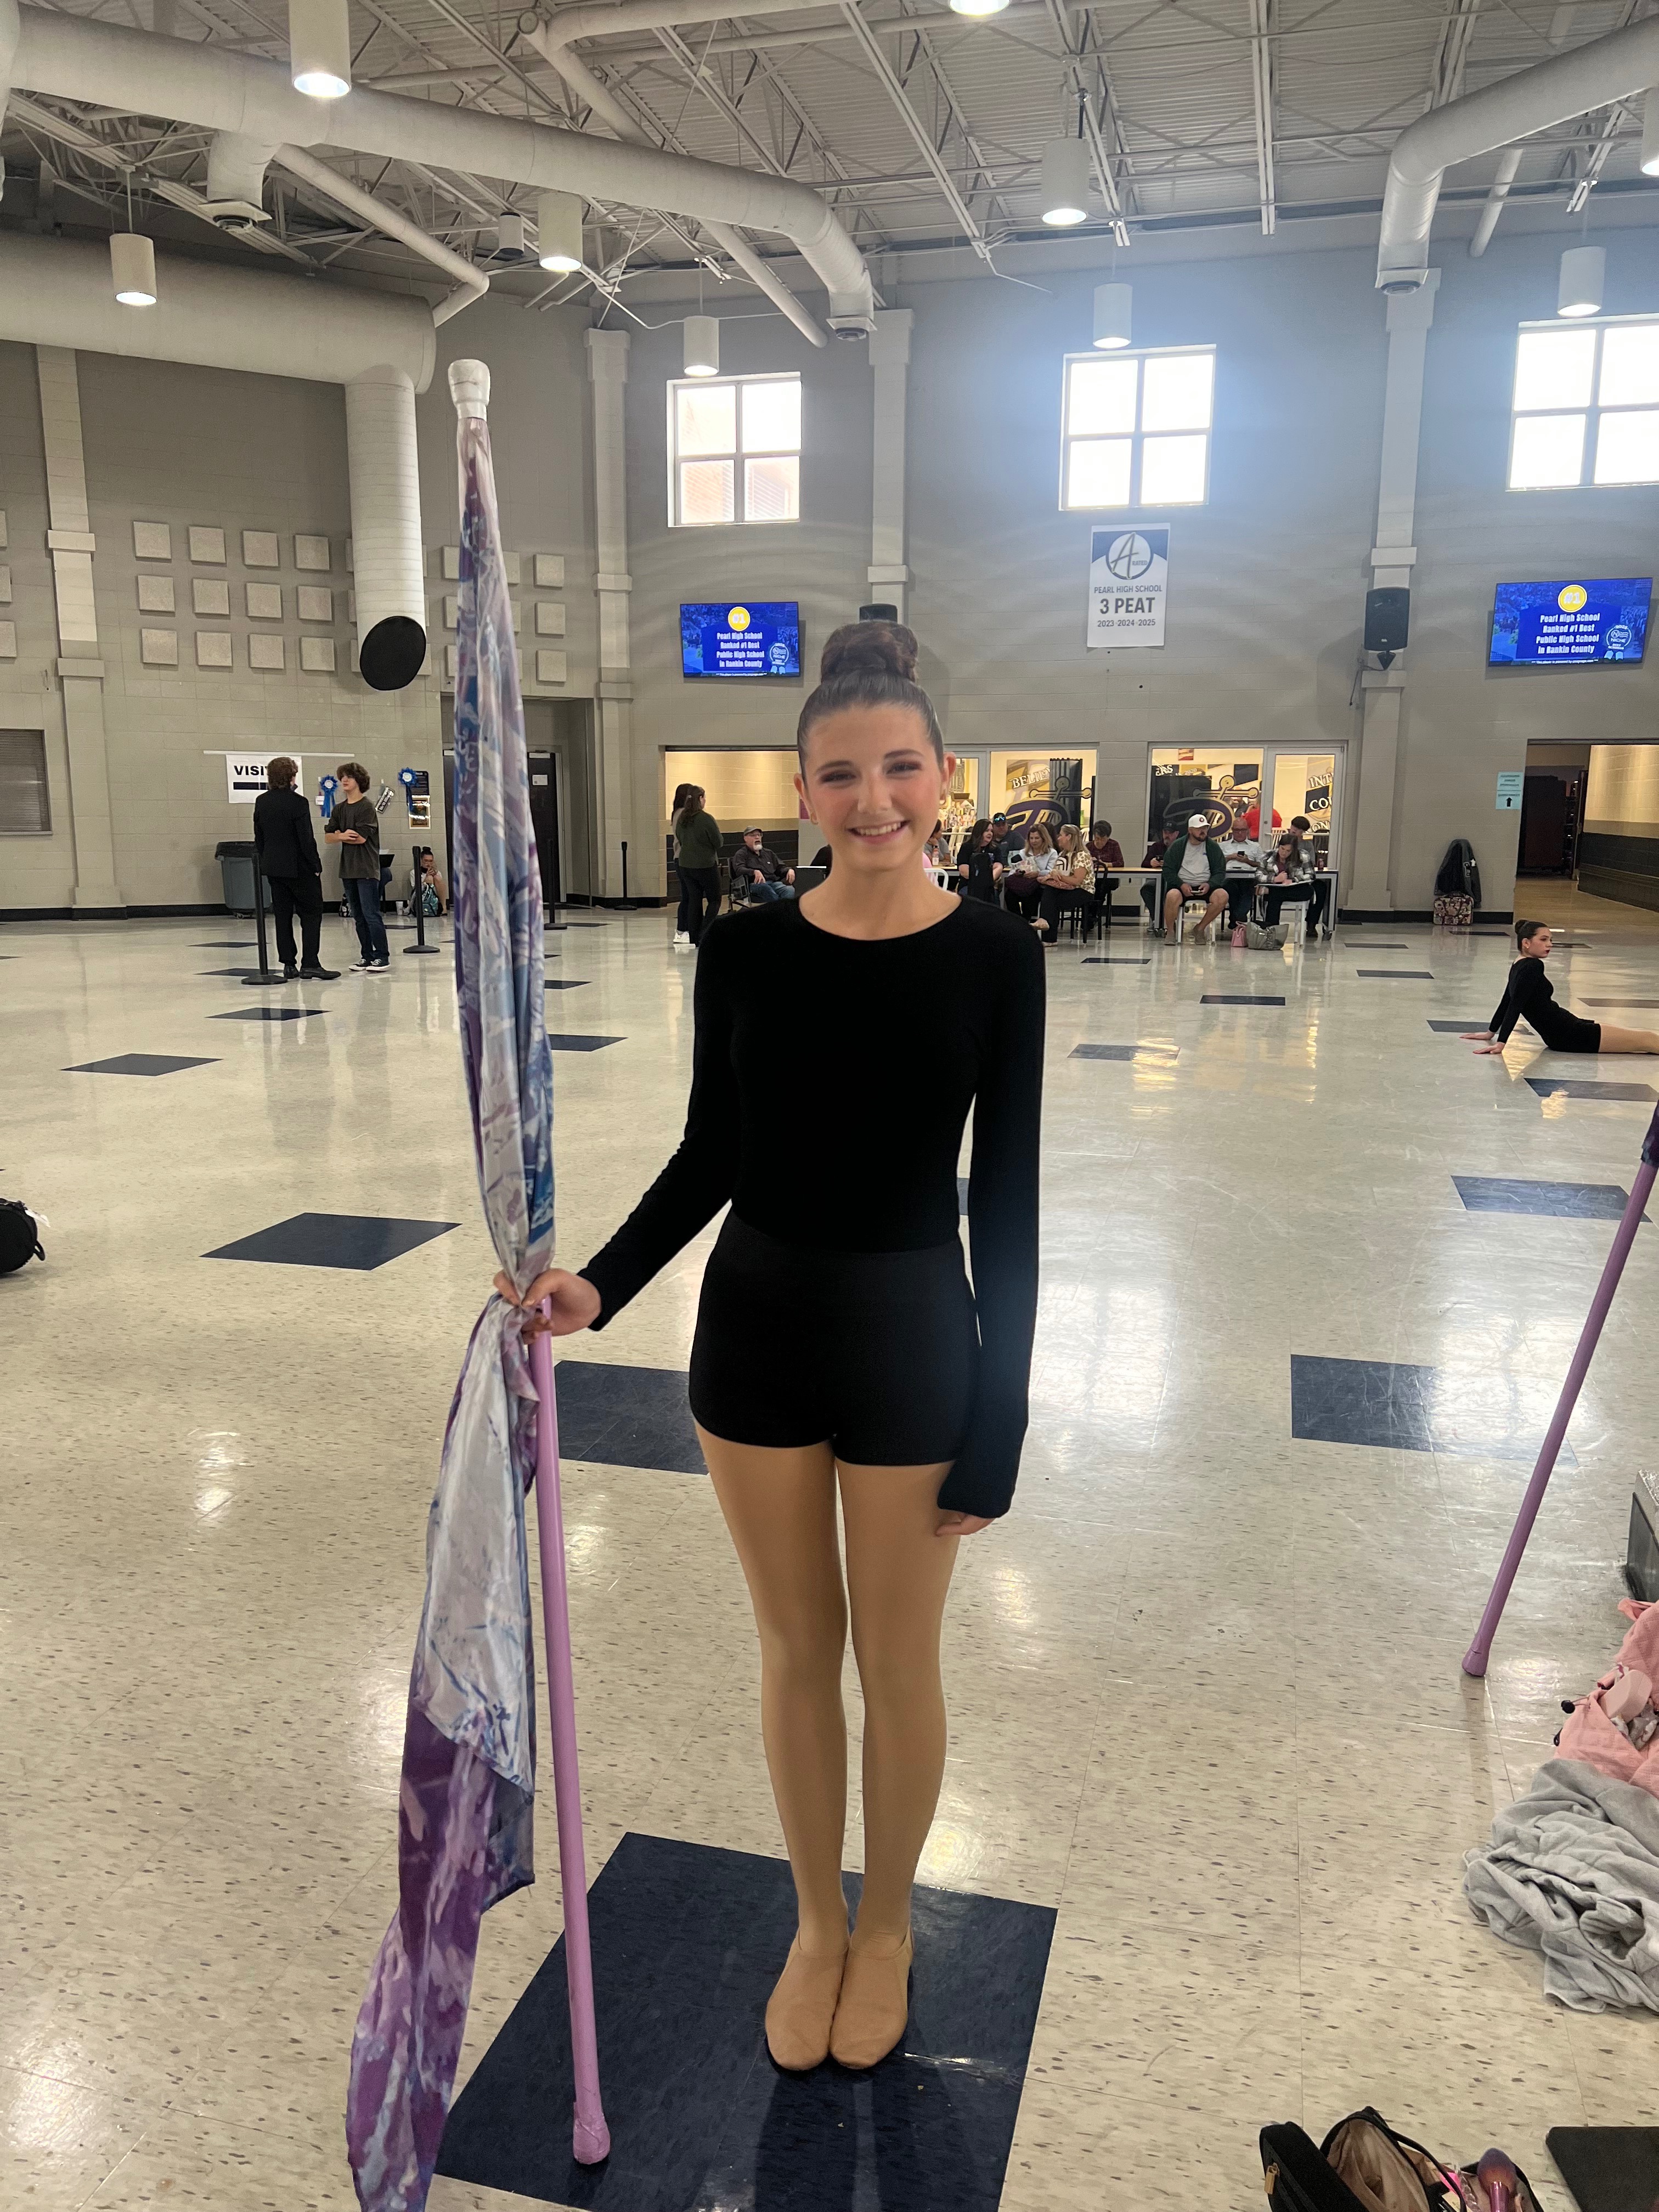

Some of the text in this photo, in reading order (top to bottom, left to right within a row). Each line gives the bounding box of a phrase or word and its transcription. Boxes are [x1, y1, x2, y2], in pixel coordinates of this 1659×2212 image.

[1135, 584, 1163, 592] SCHOOL
[1564, 592, 1581, 605] #1
[1100, 597, 1155, 614] 3 PEAT
[732, 613, 746, 624] #1
[1540, 613, 1600, 623] Pearl High School
[1543, 624, 1595, 633] Ranked #1 Best
[731, 632, 744, 640] High
[1536, 634, 1600, 644] Public High School
[747, 641, 760, 649] Best
[1546, 645, 1570, 654] Rankin
[1571, 645, 1595, 653] County
[725, 659, 744, 668] Rankin
[744, 659, 763, 668] County
